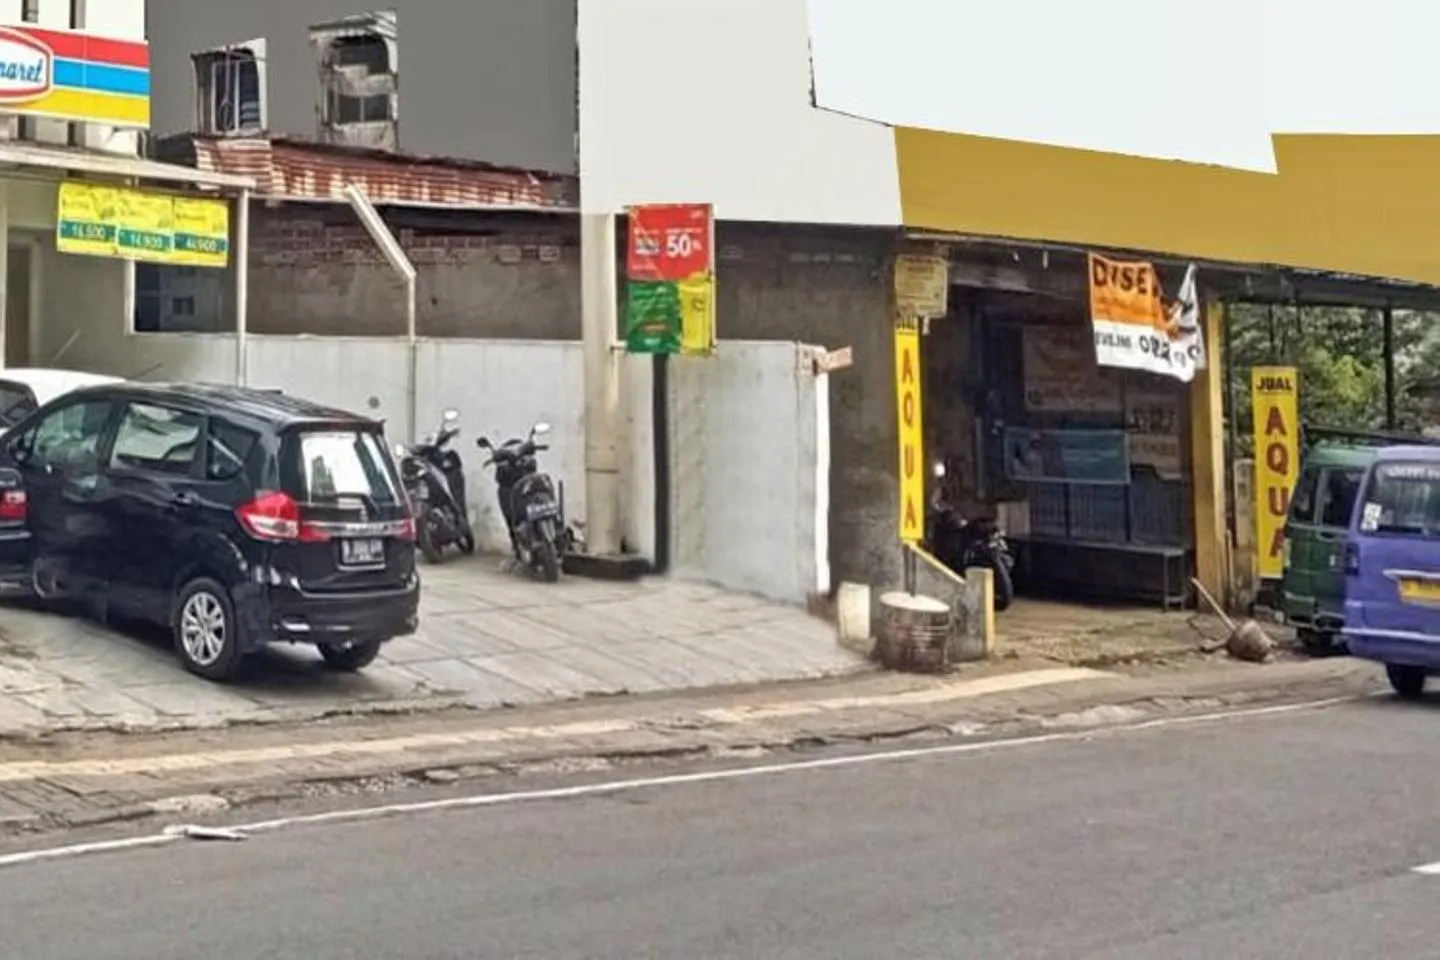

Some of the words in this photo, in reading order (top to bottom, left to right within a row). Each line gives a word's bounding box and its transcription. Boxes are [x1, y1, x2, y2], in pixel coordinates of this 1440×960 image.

[901, 348, 917, 530] AQUA
[1256, 376, 1293, 391] JUAL
[1264, 405, 1291, 558] AQUA
